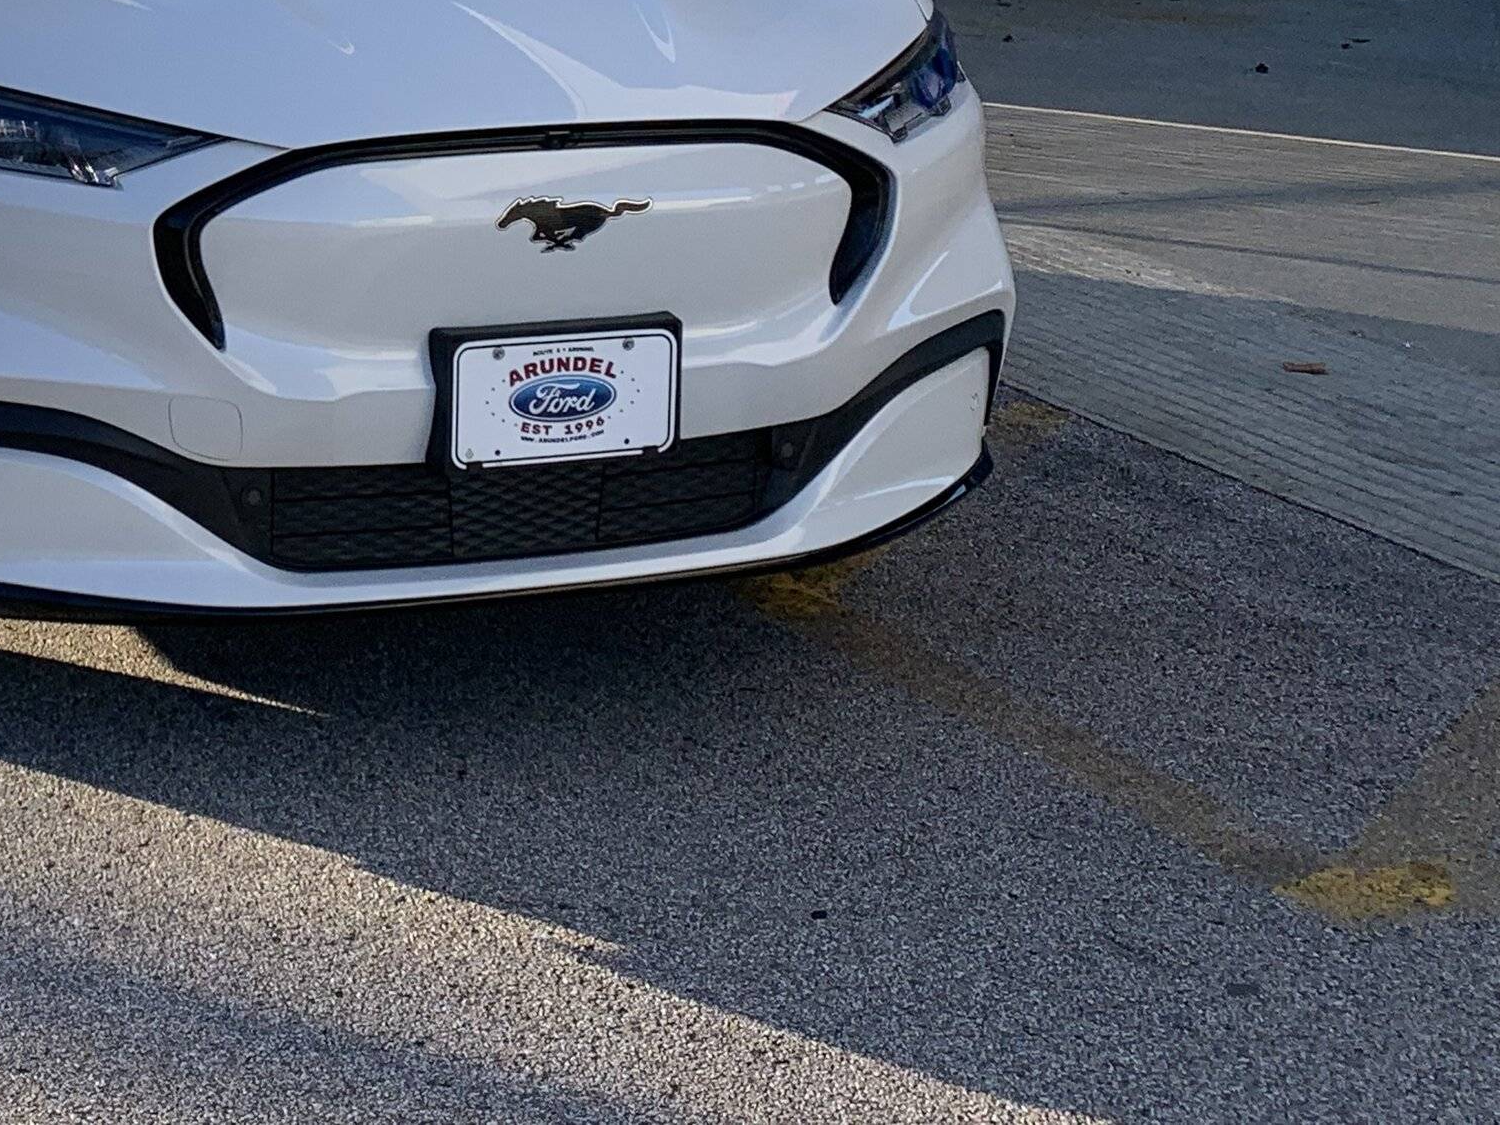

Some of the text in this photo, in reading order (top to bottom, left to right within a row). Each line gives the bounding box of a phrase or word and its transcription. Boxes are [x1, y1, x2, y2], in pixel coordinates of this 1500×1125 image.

[509, 357, 617, 387] ARUNDEL
[528, 382, 596, 415] Ford
[520, 417, 604, 435] EST 1996
